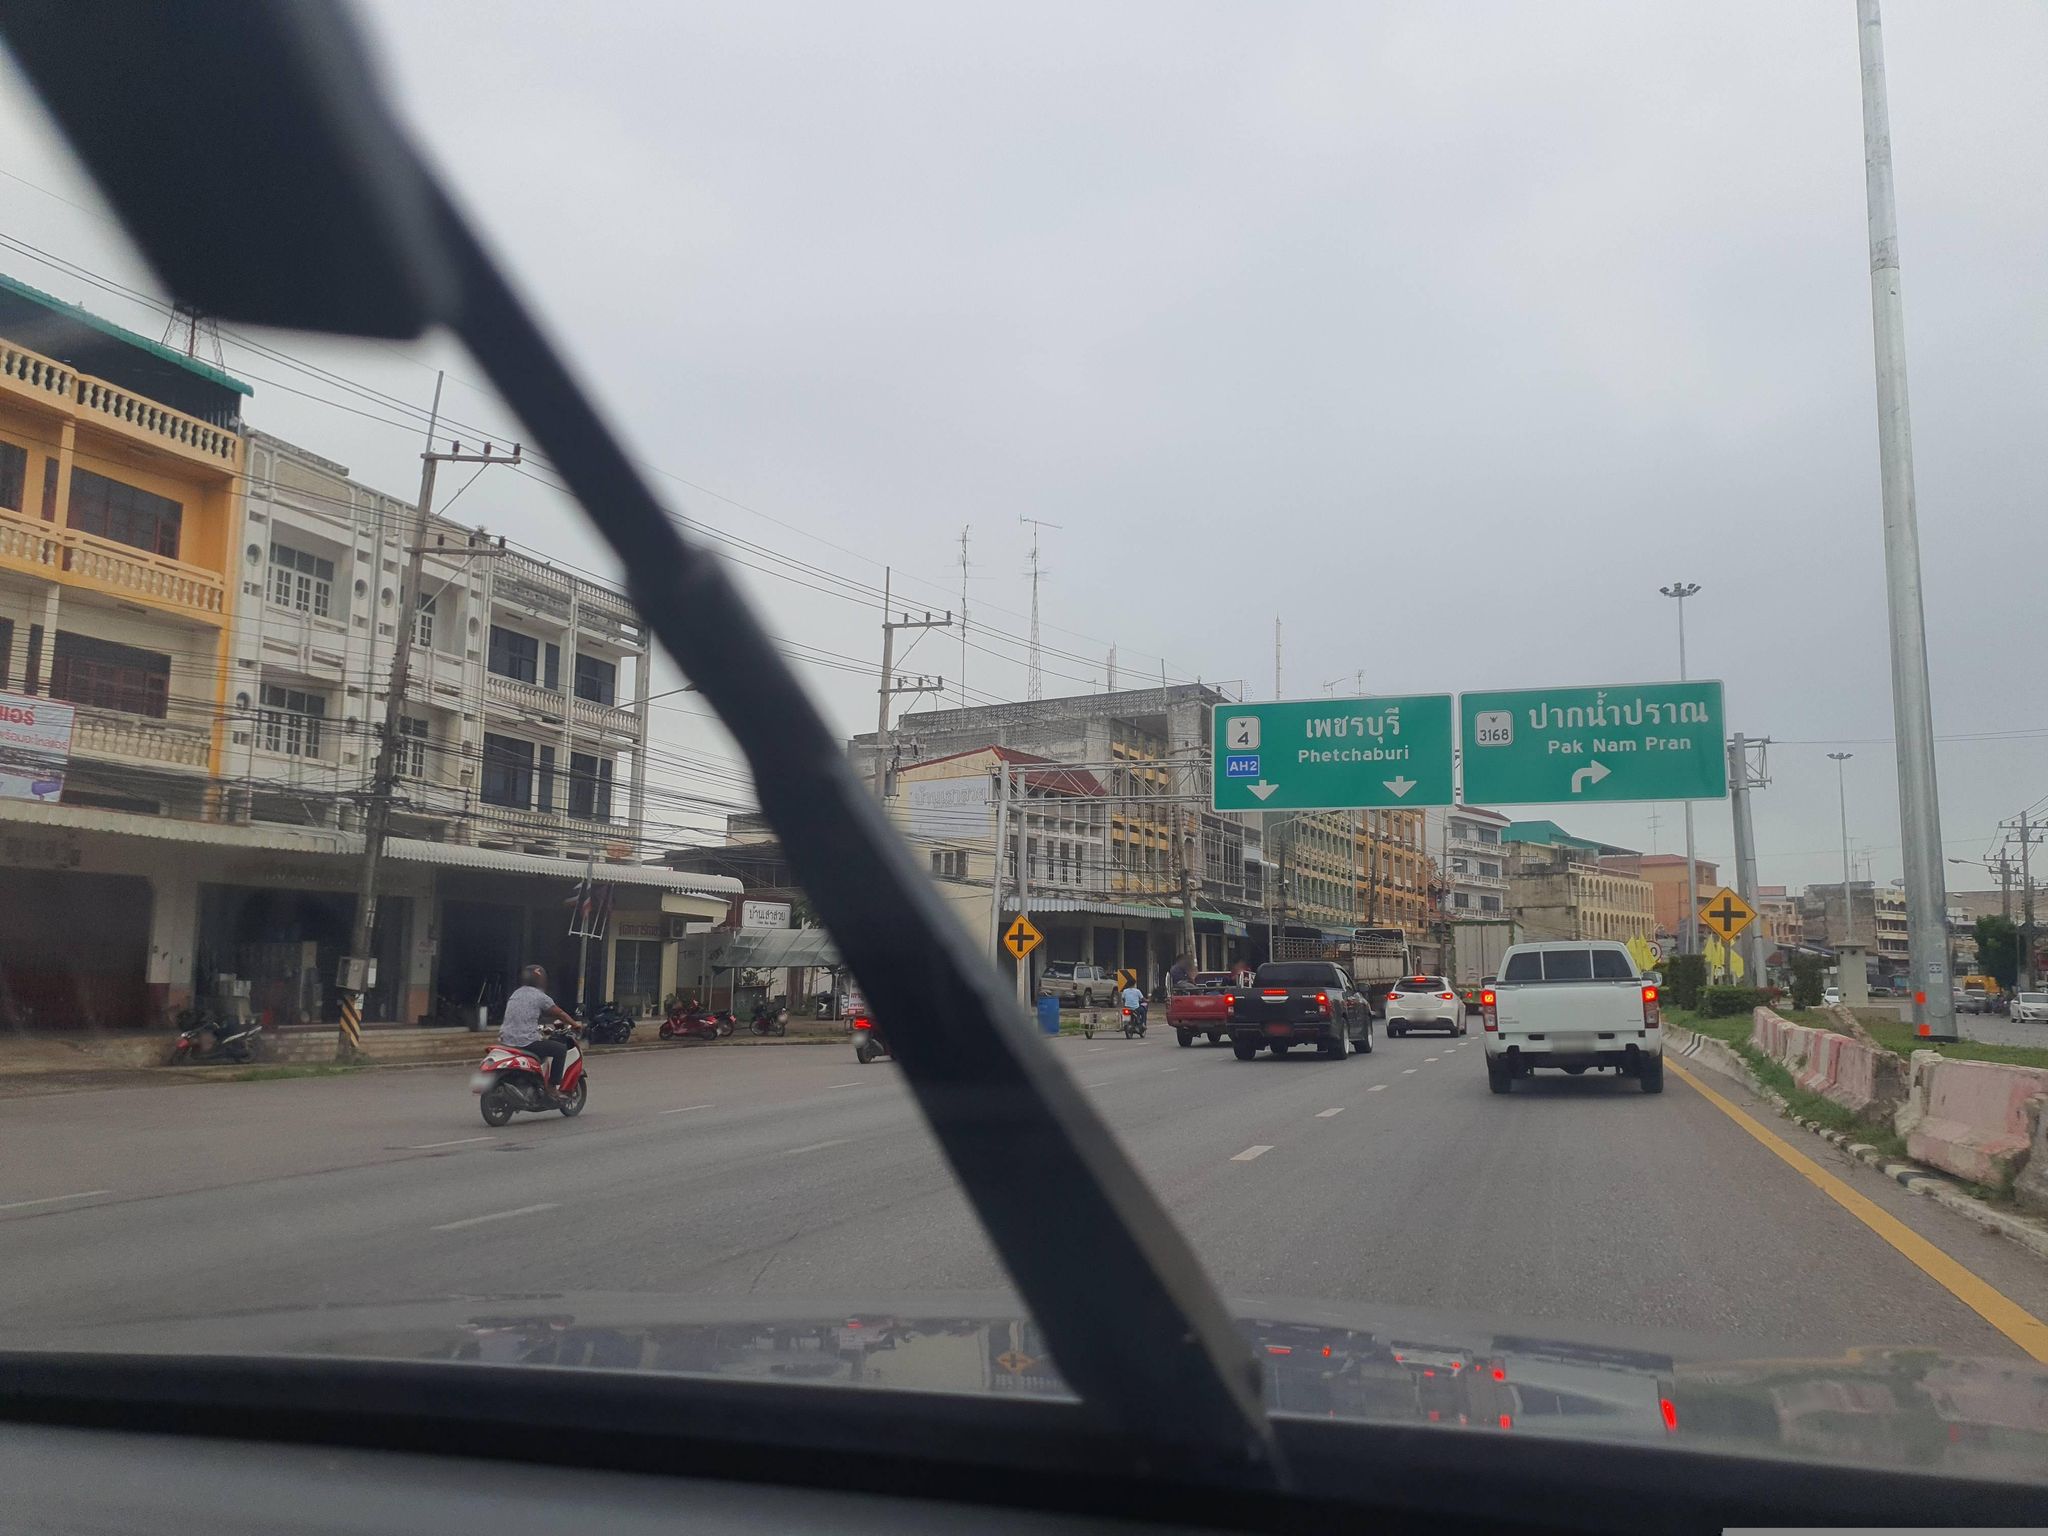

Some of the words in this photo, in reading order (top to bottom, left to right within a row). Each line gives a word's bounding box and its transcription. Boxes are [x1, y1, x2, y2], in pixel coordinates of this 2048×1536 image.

[1528, 691, 1709, 729] ปากน้ำปราณ
[1306, 707, 1401, 744] เพชรบุรี
[1237, 731, 1250, 745] 4
[1479, 728, 1510, 742] 3168
[1298, 745, 1410, 763] Phetchaburi
[1548, 739, 1584, 754] Pak
[1592, 737, 1637, 753] Nam
[1645, 736, 1692, 750] Pran
[1229, 760, 1258, 772] AH2
